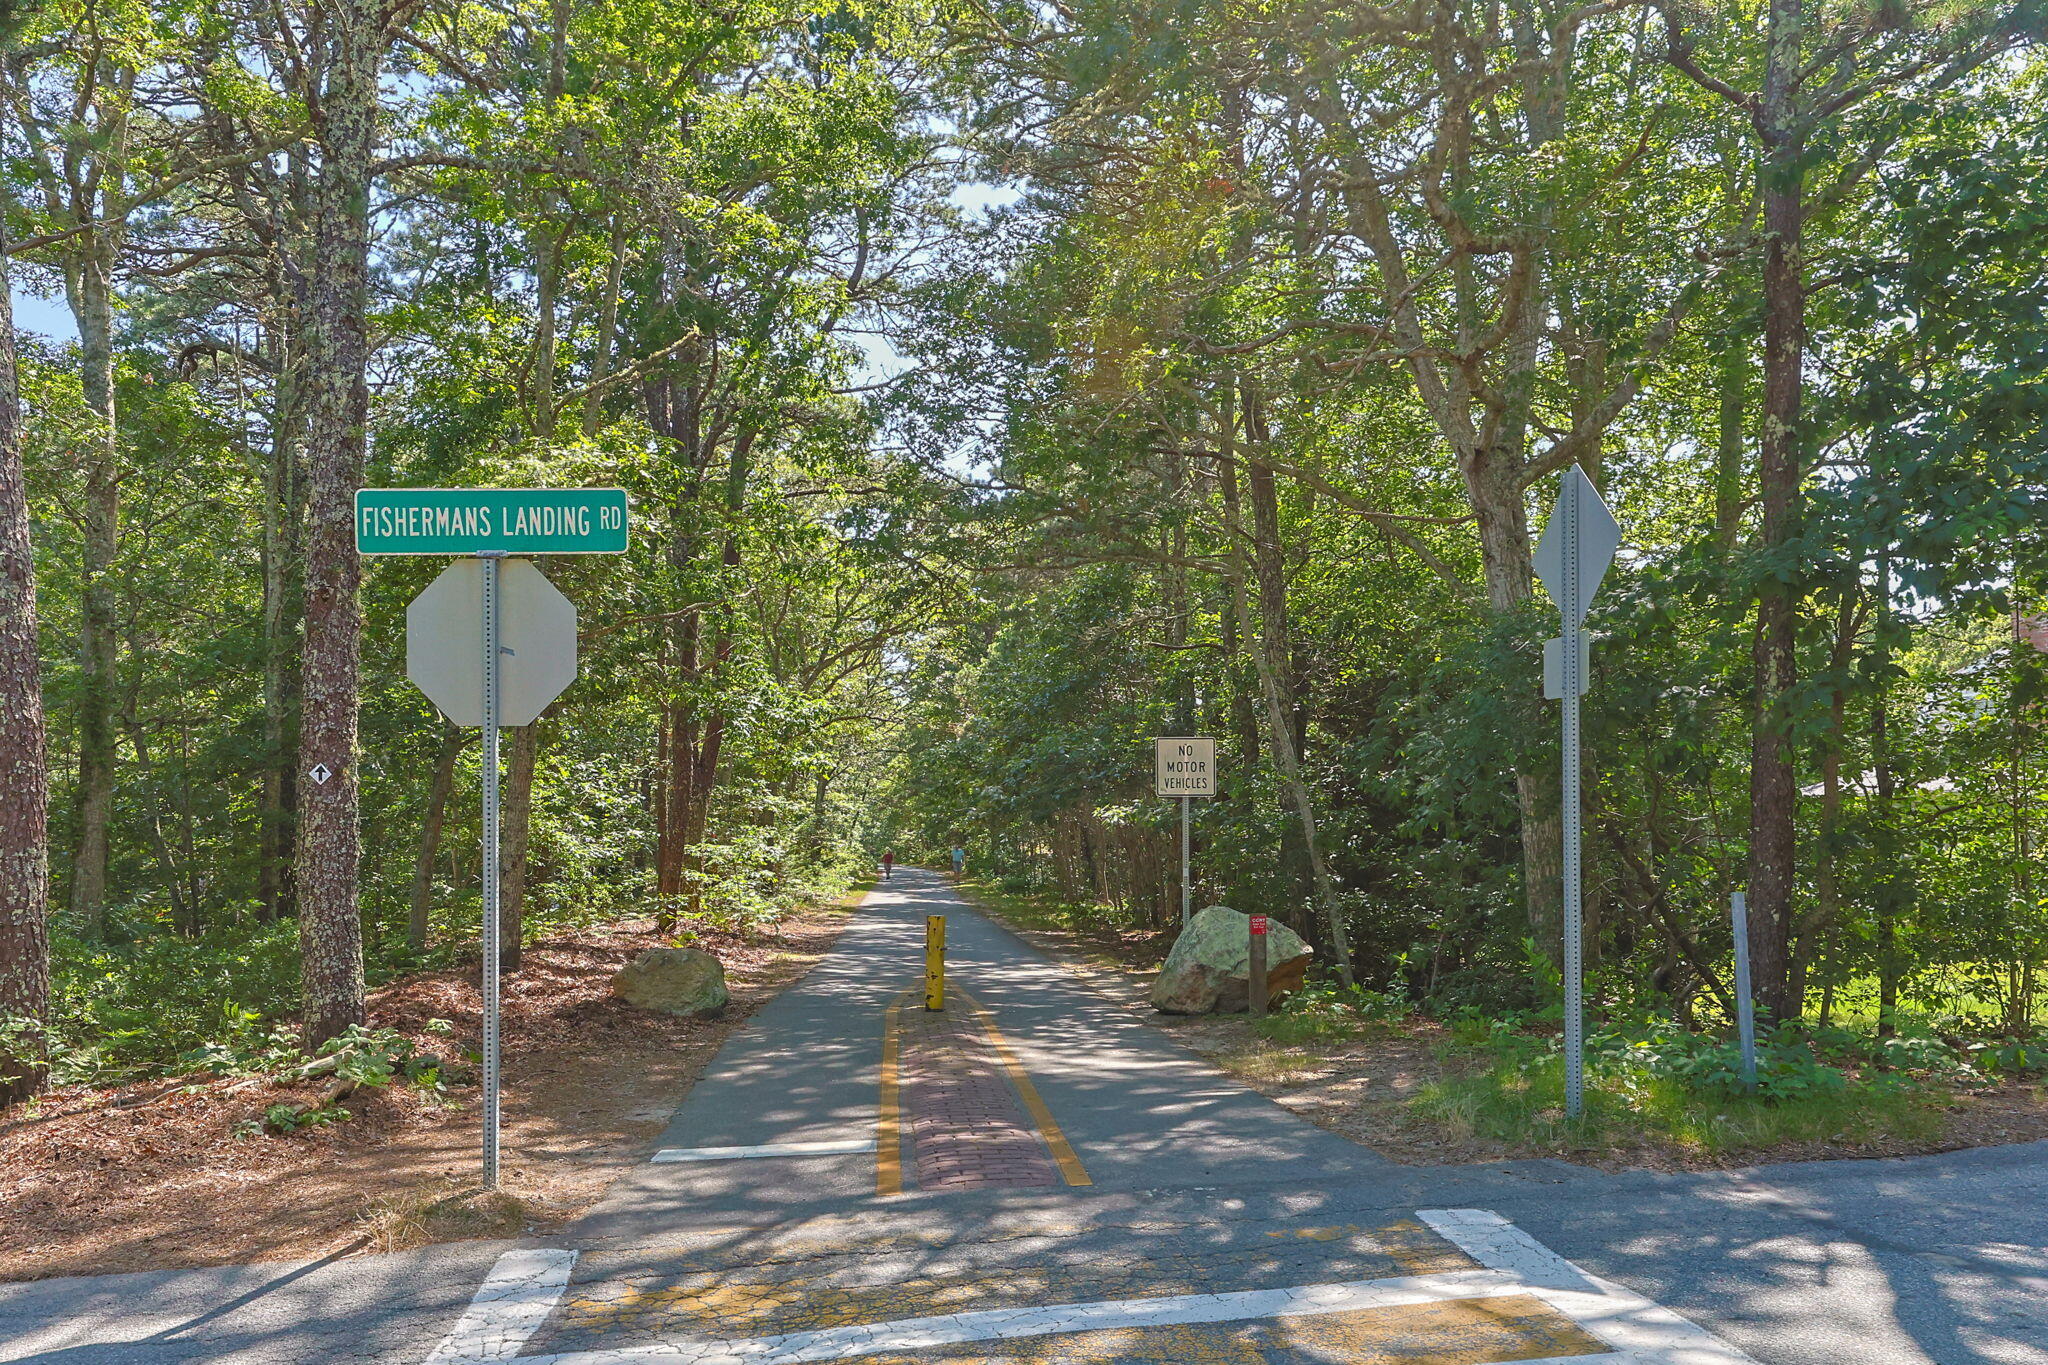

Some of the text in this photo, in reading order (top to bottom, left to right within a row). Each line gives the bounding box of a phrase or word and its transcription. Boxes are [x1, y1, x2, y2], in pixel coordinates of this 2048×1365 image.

[362, 506, 621, 537] FISHERMANS LANDING RD
[1178, 745, 1193, 756] NO
[1167, 762, 1205, 772] MOTOR
[1164, 778, 1207, 789] VEHICLES
